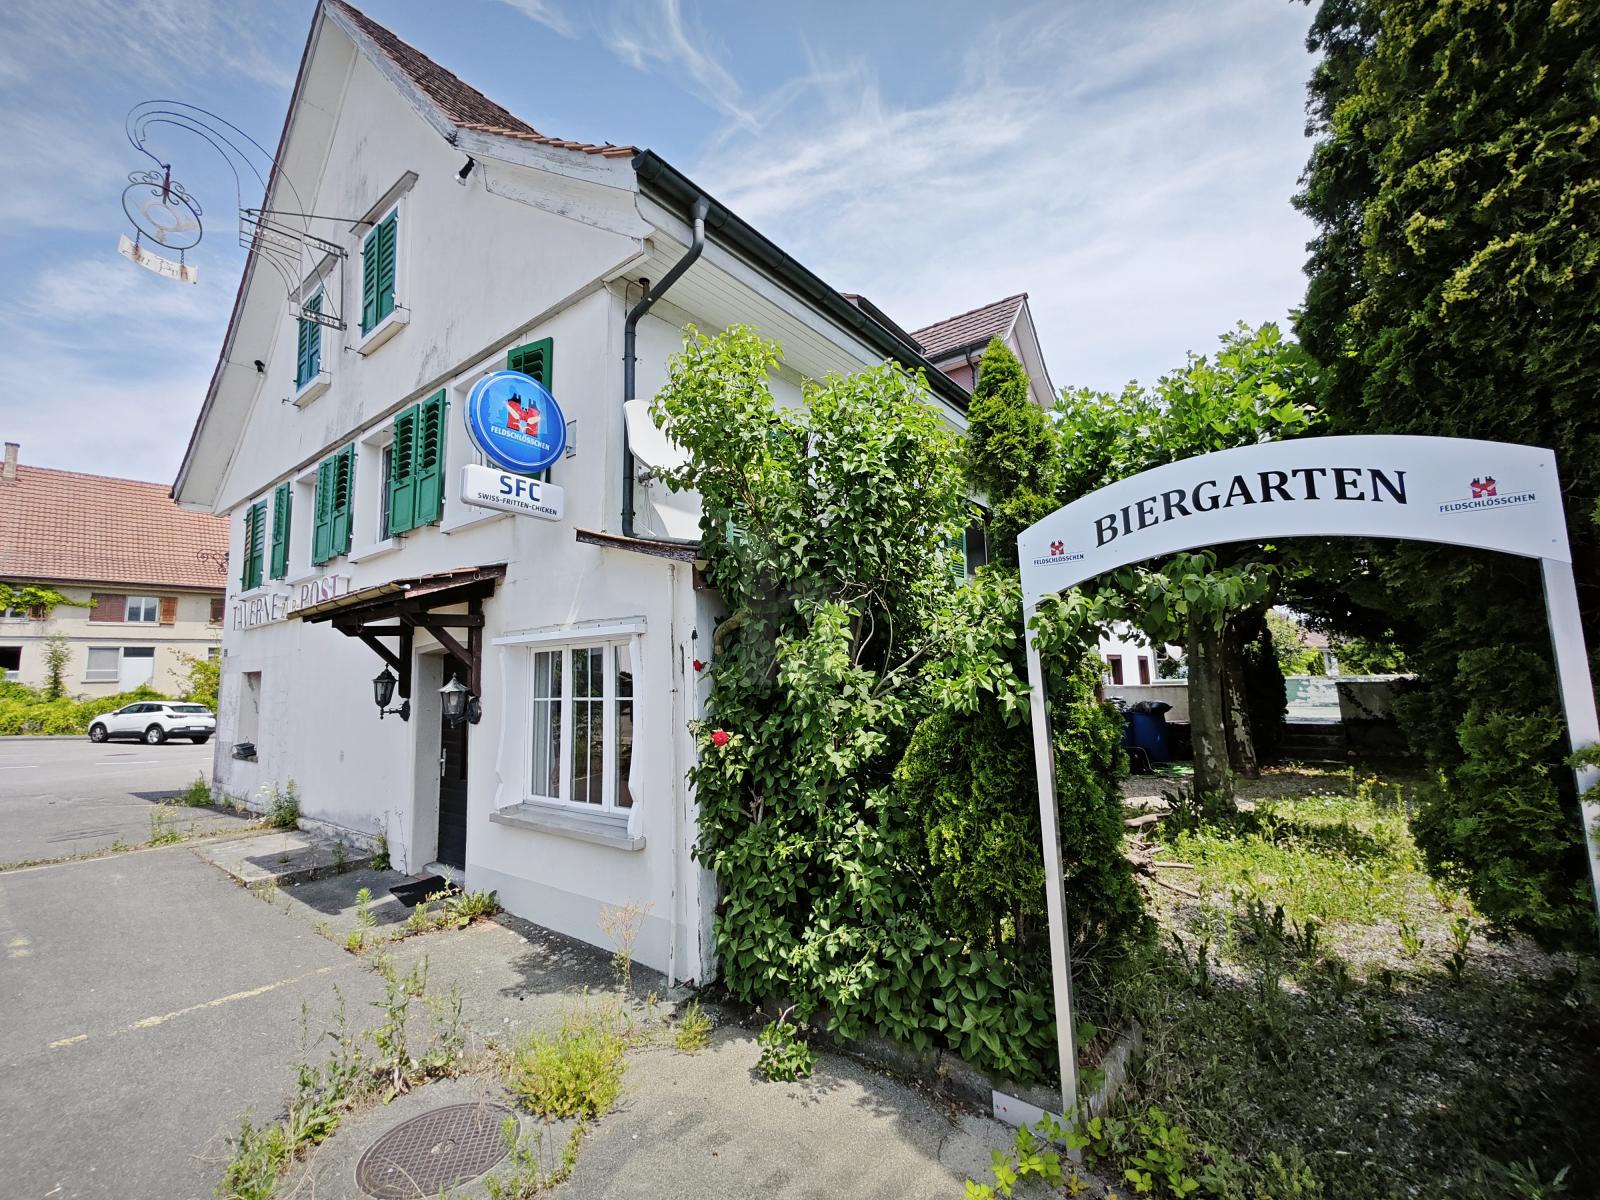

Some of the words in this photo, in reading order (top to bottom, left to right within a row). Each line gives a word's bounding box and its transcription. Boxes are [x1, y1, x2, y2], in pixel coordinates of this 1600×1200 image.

[490, 425, 551, 451] FELDSCHLÖSSCHEN
[499, 474, 541, 502] SFC
[477, 492, 558, 516] SWISS-FRITTEN-CHICKEN
[1092, 466, 1408, 549] BIERGARTEN
[1439, 493, 1536, 513] FELDSCHLÖSSCHEN
[1033, 553, 1084, 566] FELDSCHLÖSSCHEN
[300, 574, 340, 609] POST
